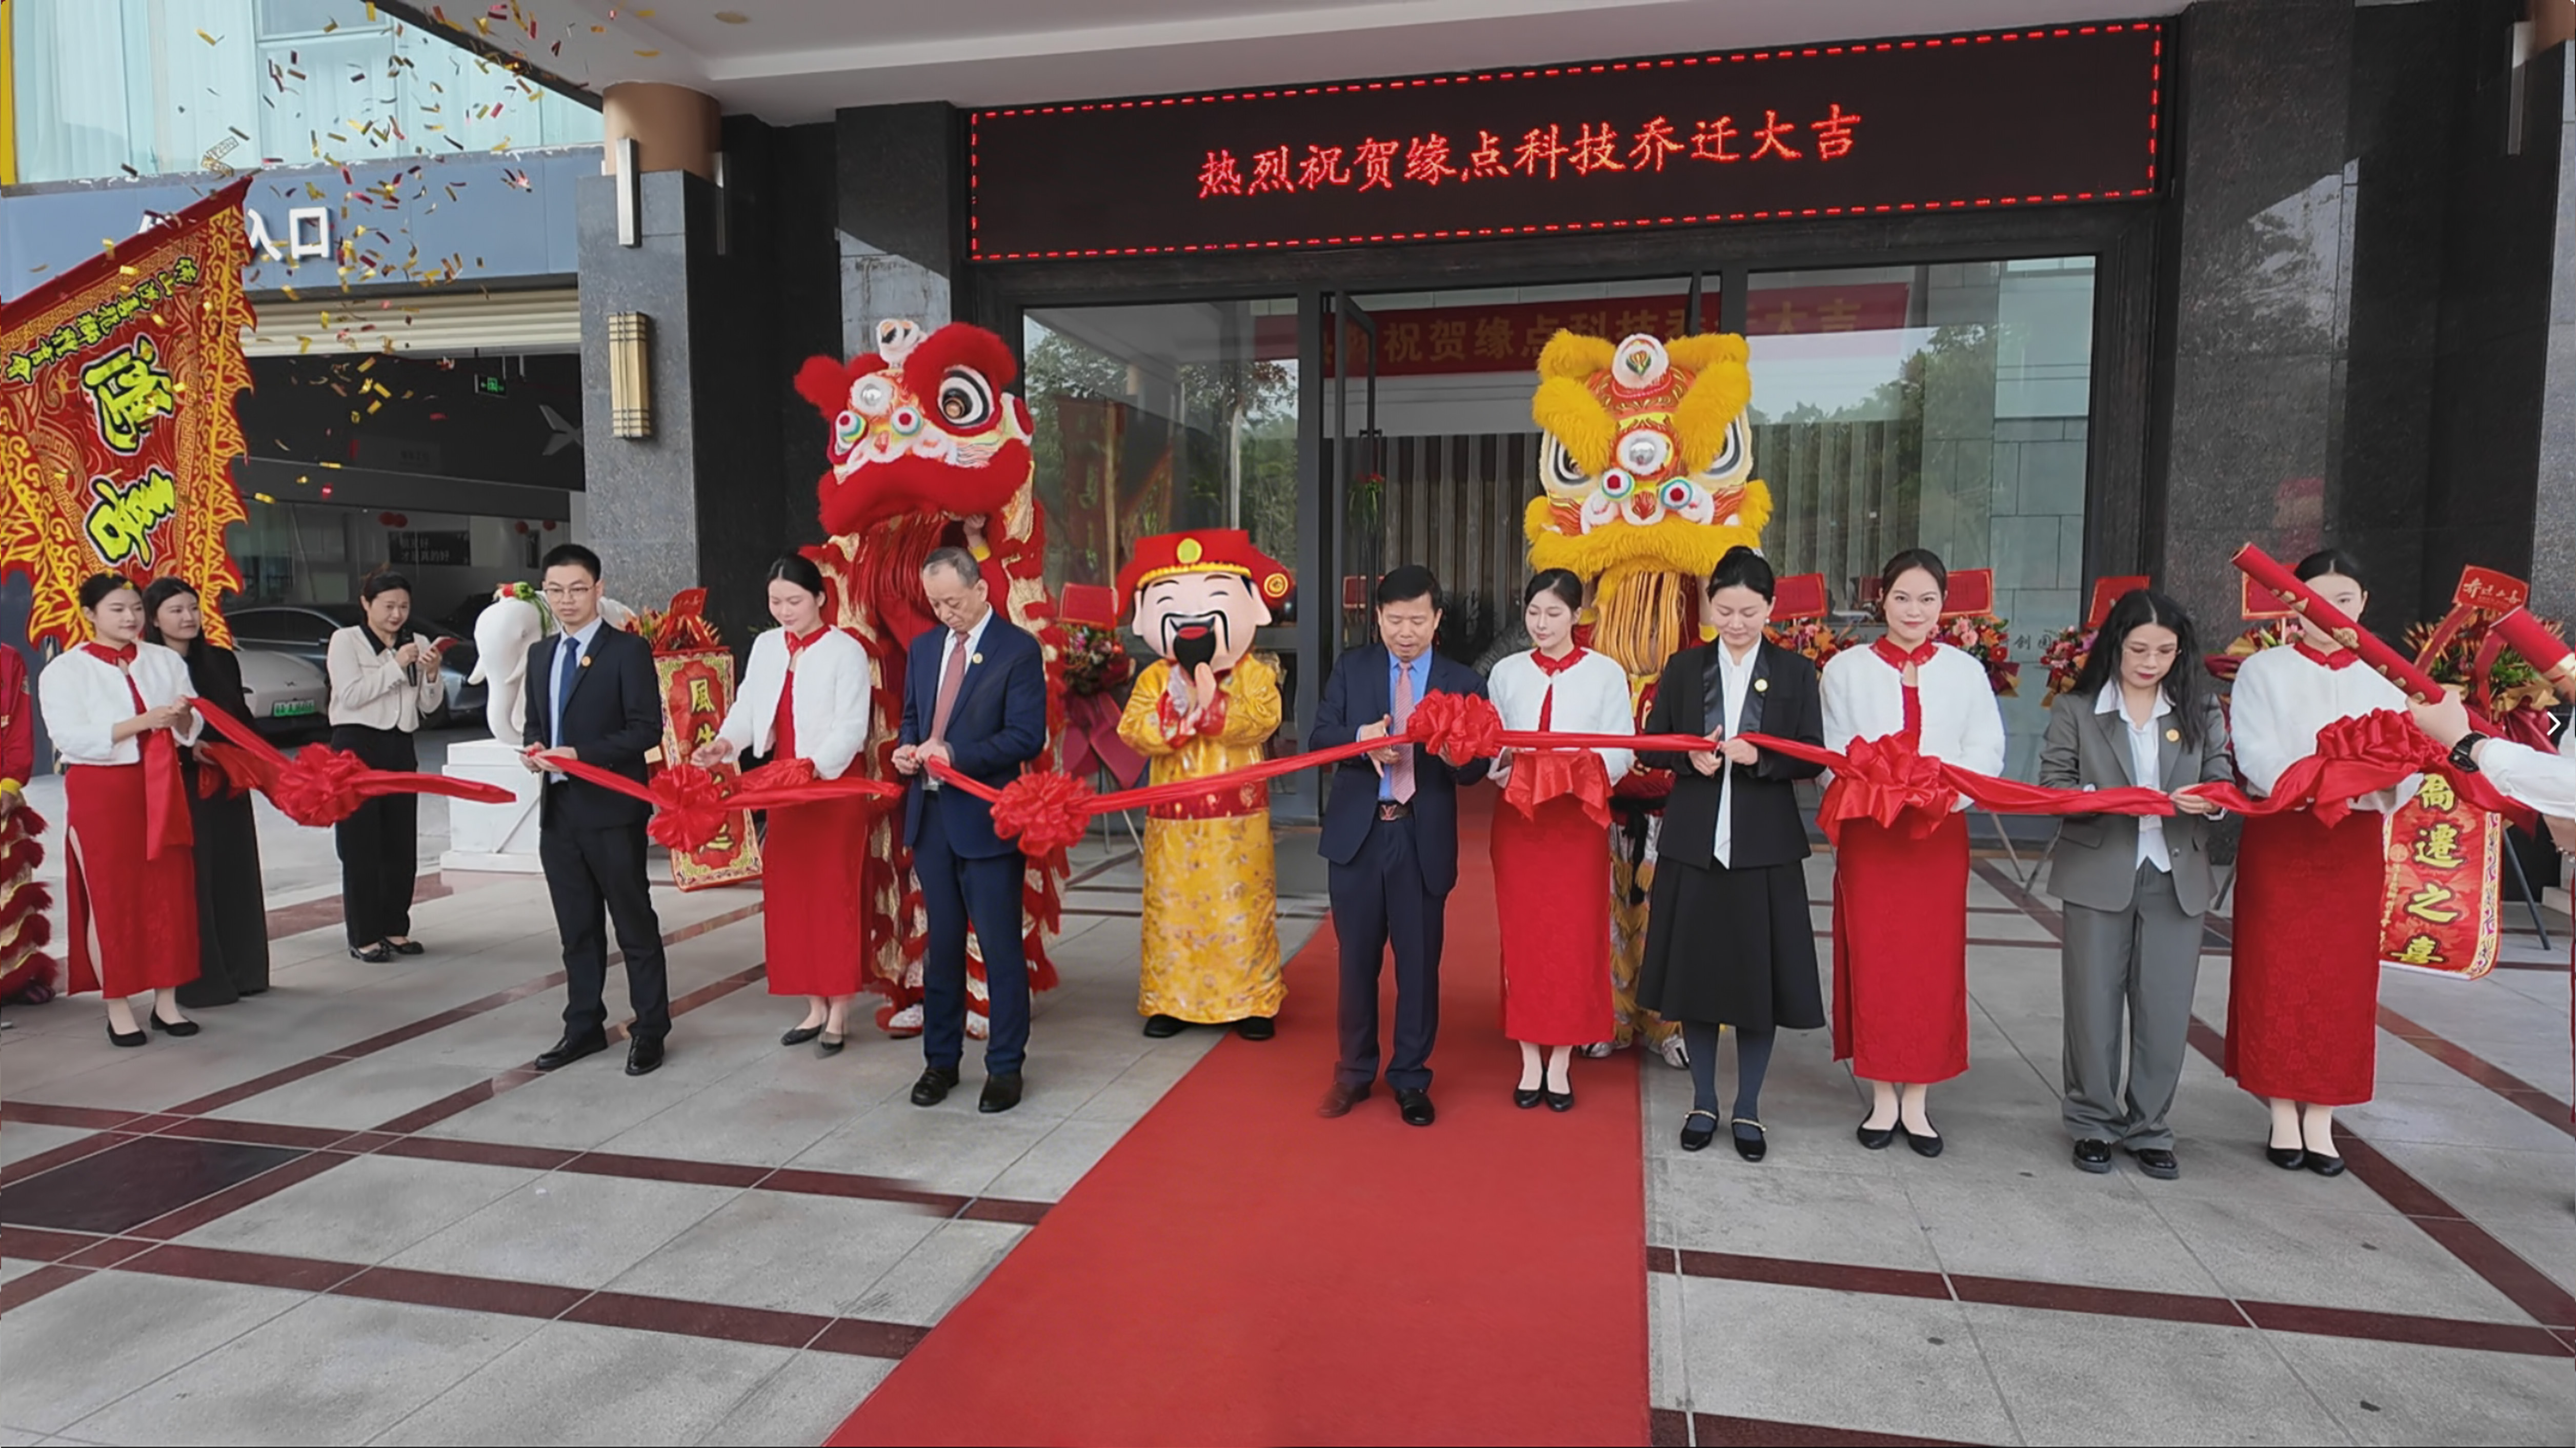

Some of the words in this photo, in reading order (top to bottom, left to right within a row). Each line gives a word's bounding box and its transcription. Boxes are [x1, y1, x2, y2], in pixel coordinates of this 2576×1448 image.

[1198, 104, 1861, 198] 热烈祝贺缘点科技乔迁大吉
